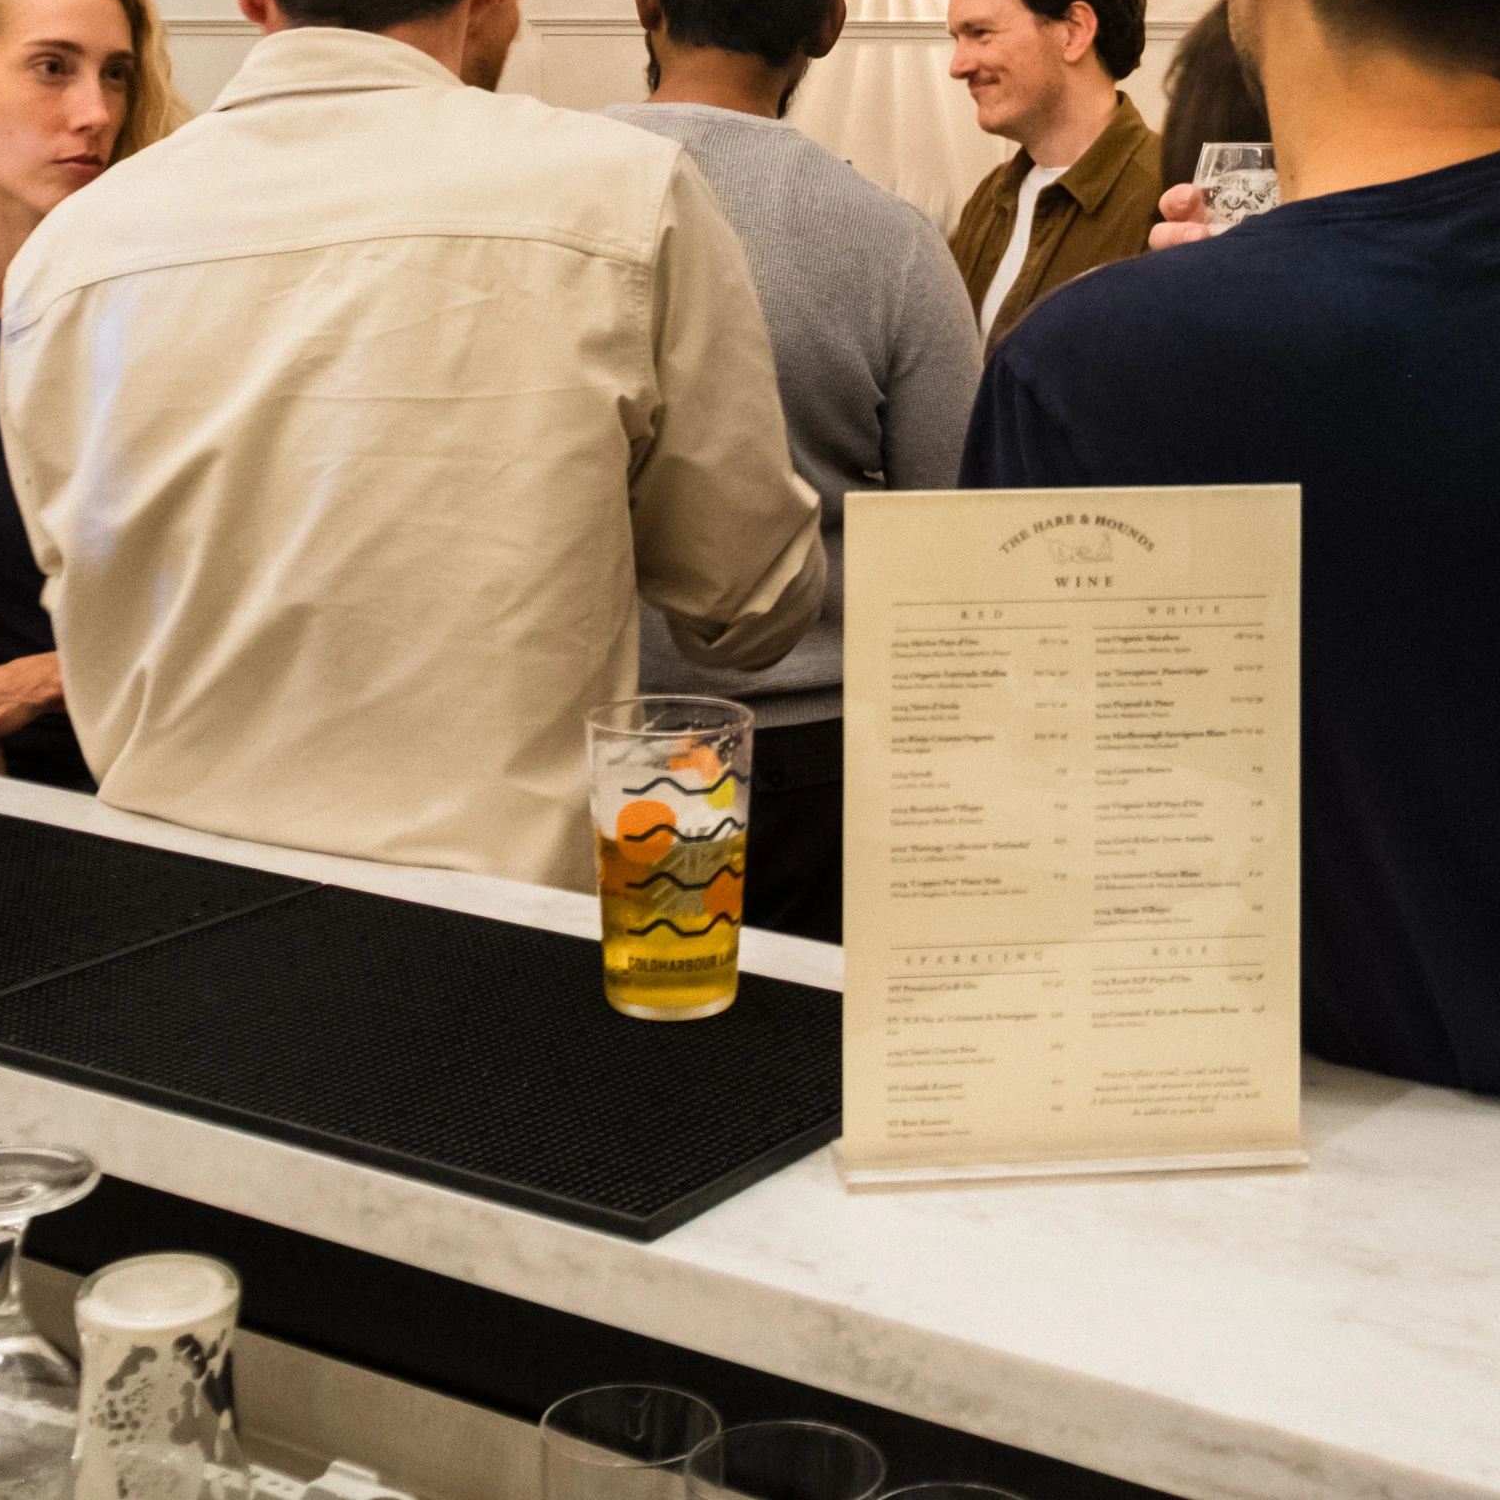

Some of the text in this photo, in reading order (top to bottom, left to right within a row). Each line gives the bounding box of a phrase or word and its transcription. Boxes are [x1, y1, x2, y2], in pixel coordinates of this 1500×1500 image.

[999, 513, 1155, 554] THE HARE & HOUNDS
[1054, 575, 1115, 588] WINE
[960, 610, 1003, 620] RED
[1146, 605, 1221, 616] WHITE
[628, 954, 717, 973] COLDHARBOUR
